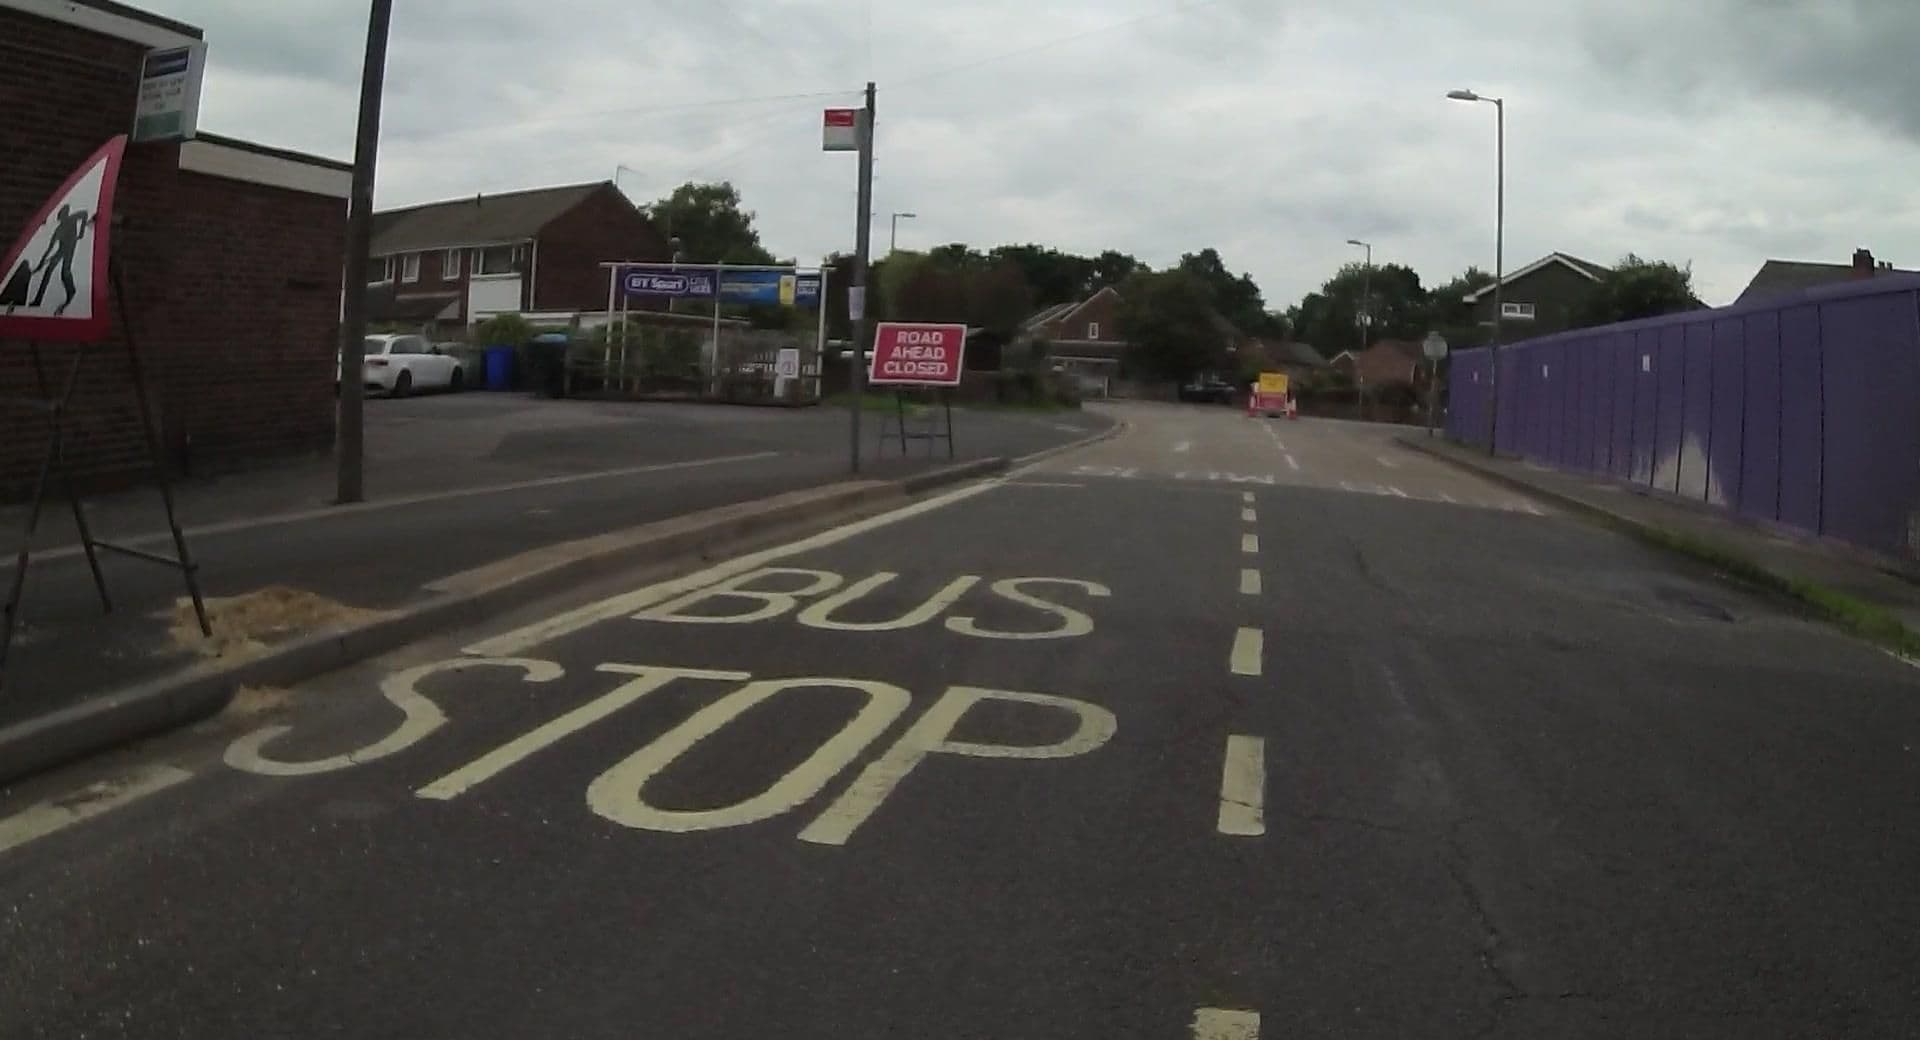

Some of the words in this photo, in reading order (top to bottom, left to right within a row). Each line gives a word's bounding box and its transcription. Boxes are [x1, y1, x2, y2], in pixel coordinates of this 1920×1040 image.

[897, 331, 944, 345] ROAD
[890, 346, 946, 361] AHEAD
[883, 361, 949, 376] CLOSED
[634, 568, 1112, 640] BUS
[223, 658, 1118, 846] STOP
